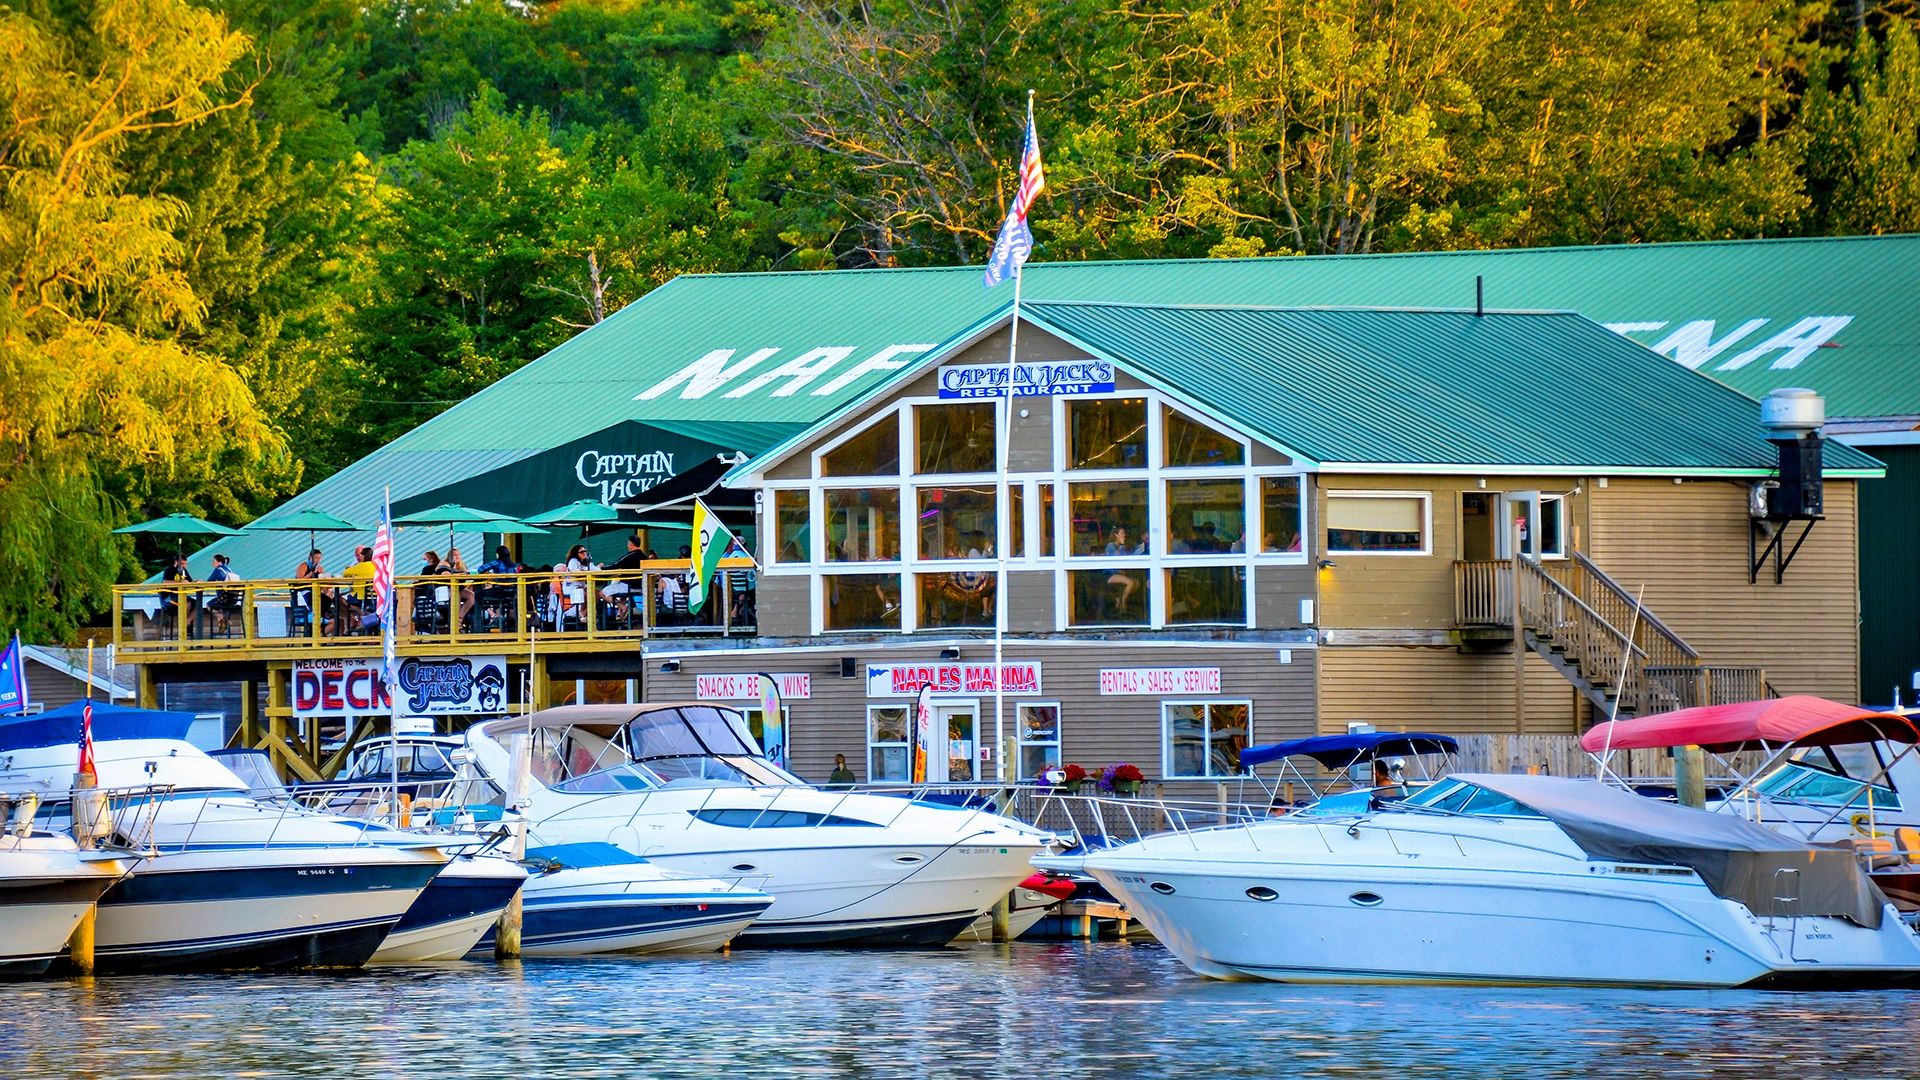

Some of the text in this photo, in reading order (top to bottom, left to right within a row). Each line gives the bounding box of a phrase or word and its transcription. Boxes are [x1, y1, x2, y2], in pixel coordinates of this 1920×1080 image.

[943, 361, 1111, 392] CAPTAIN JACK'S
[960, 384, 1092, 398] RESTAURANT
[575, 450, 676, 487] CAPTAIN
[601, 474, 672, 507] JACK'
[295, 659, 343, 670] WELCOME
[401, 662, 471, 691] CAPTAIN
[892, 666, 962, 692] NAPLES
[296, 669, 391, 711] DECK
[411, 680, 469, 709] JACK'S
[698, 676, 735, 697] SNACKS
[783, 675, 809, 696] WINE
[1101, 670, 1220, 692] RENTALS SALES SERVICE
